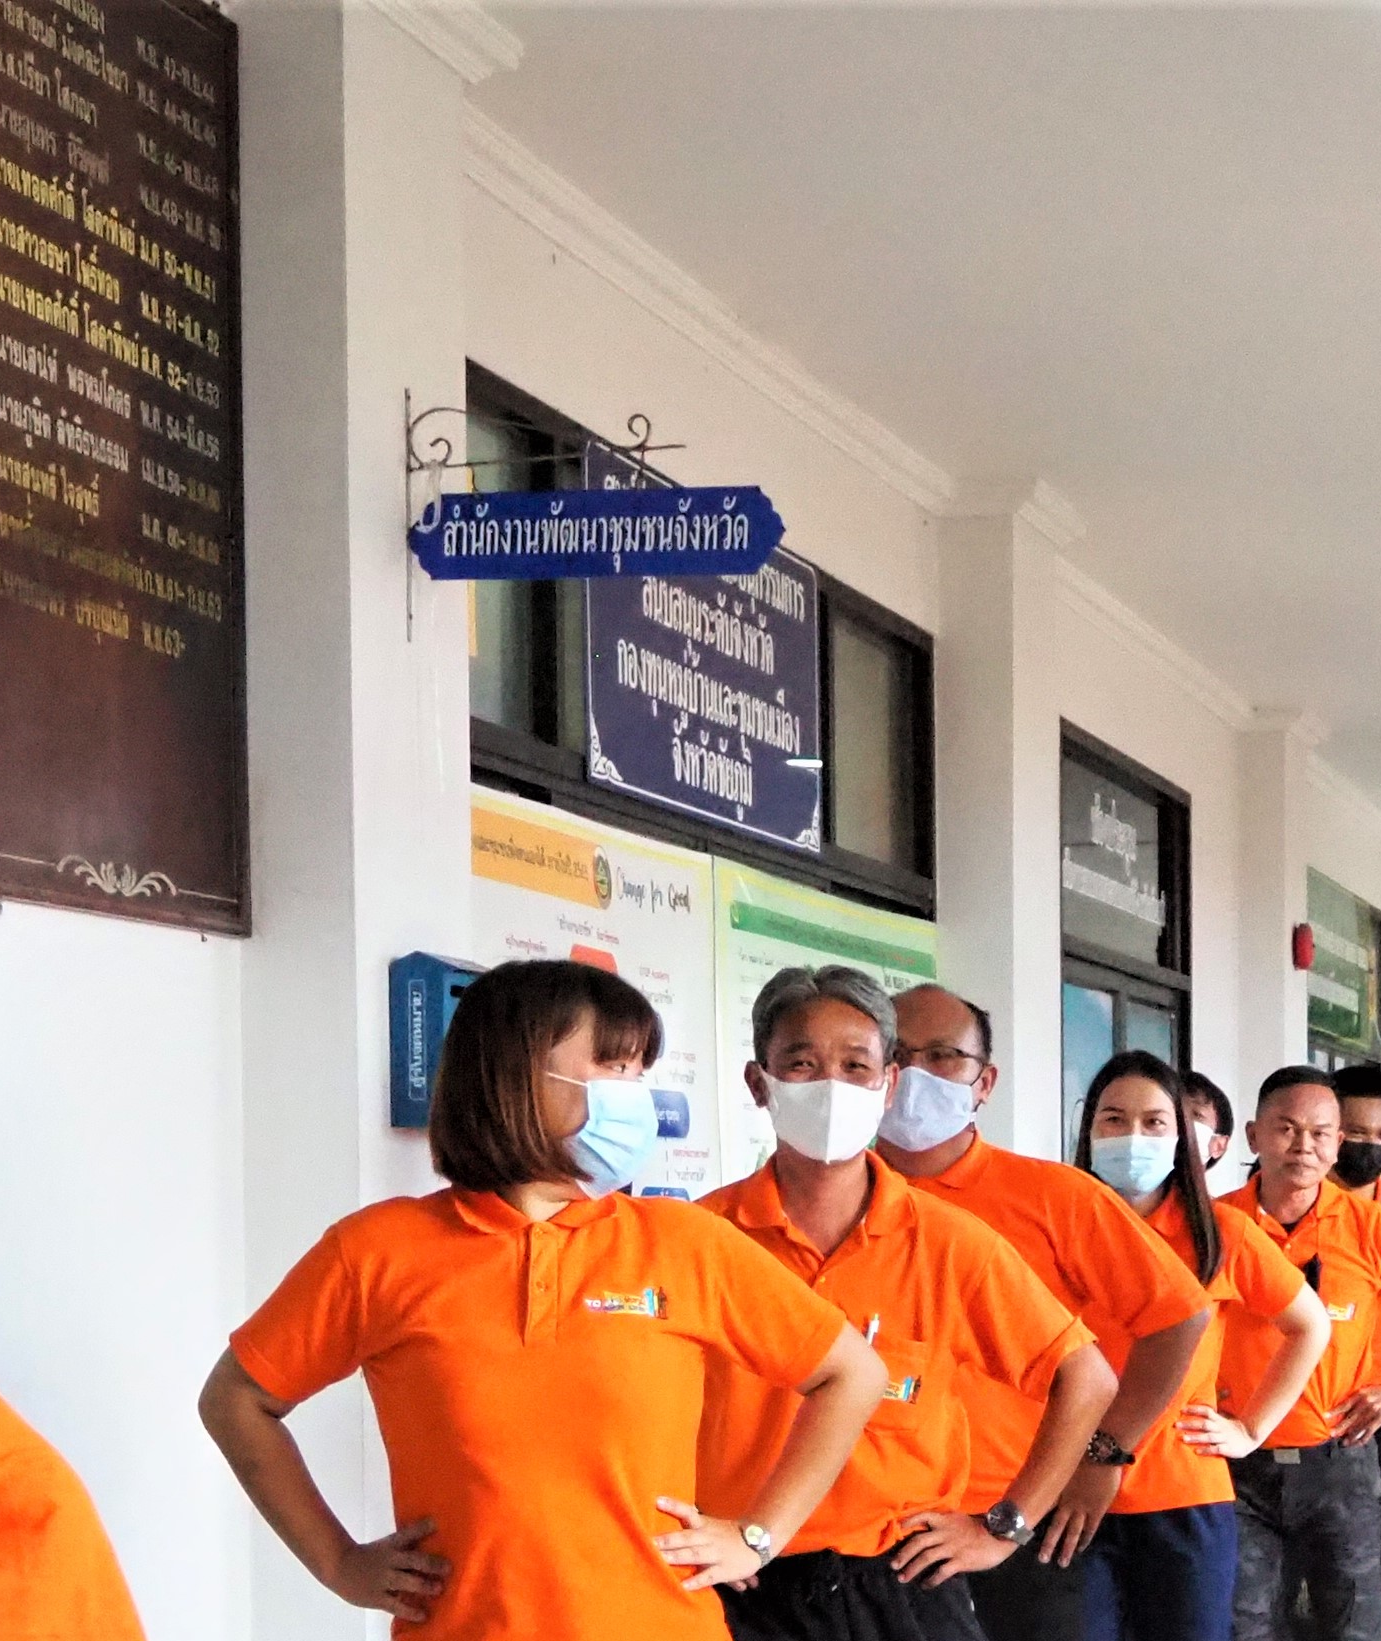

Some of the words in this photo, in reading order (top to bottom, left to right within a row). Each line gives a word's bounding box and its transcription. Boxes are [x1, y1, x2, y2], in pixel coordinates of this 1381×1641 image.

[443, 494, 748, 573] สำนักงานพัฒนาชุมชนจังหวัด
[642, 575, 774, 676] สนบสนุนระดับจังหวัด
[672, 721, 753, 821] จังหวัดชัยภูมิ
